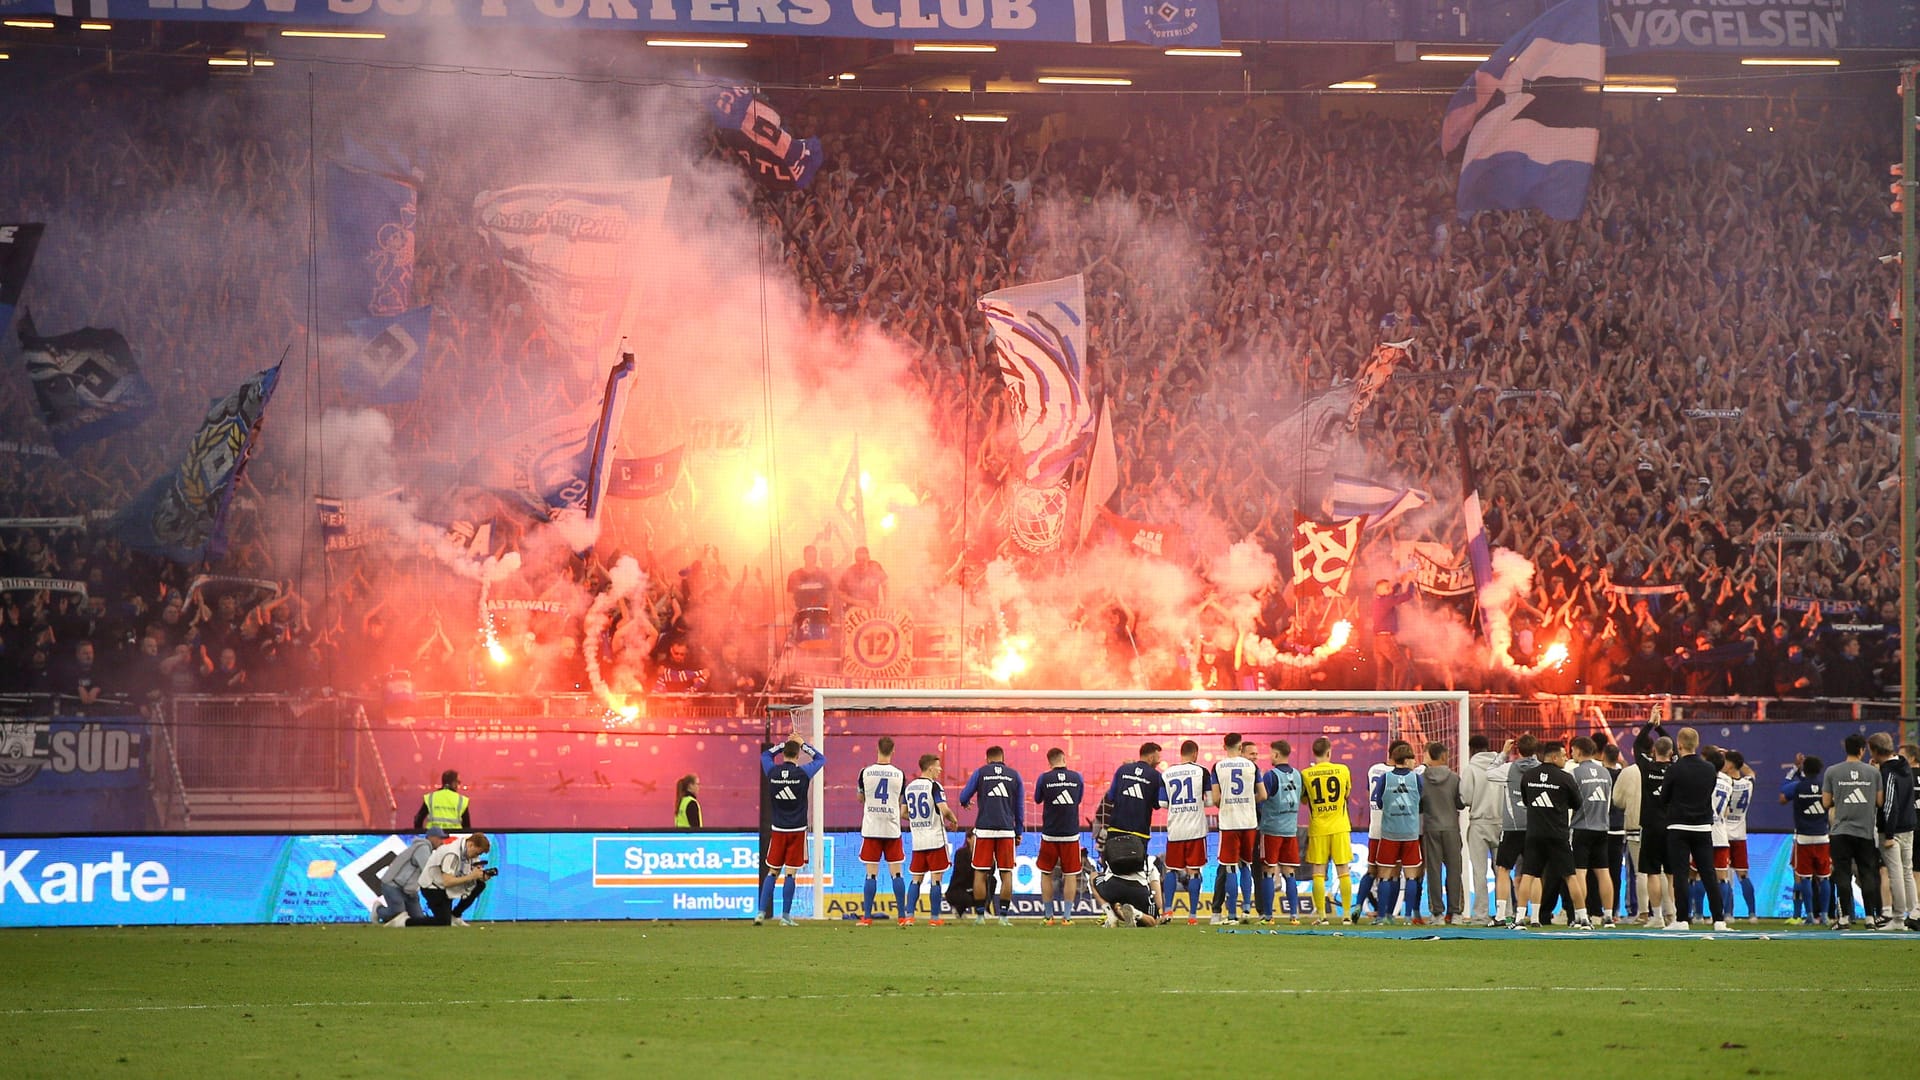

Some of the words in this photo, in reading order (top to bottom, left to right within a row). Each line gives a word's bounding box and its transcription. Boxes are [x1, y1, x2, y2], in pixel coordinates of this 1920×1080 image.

[852, 0, 1037, 29] CLUB
[863, 631, 891, 655] 12
[51, 723, 130, 774] SÜD
[874, 778, 889, 804] 4
[1169, 776, 1196, 805] 21
[1231, 769, 1244, 796] 5
[1311, 776, 1341, 804] 19
[907, 792, 931, 819] 36
[624, 846, 760, 875] Sparda-Ba
[0, 850, 186, 904] Karte.
[672, 892, 754, 912] Hamburg
